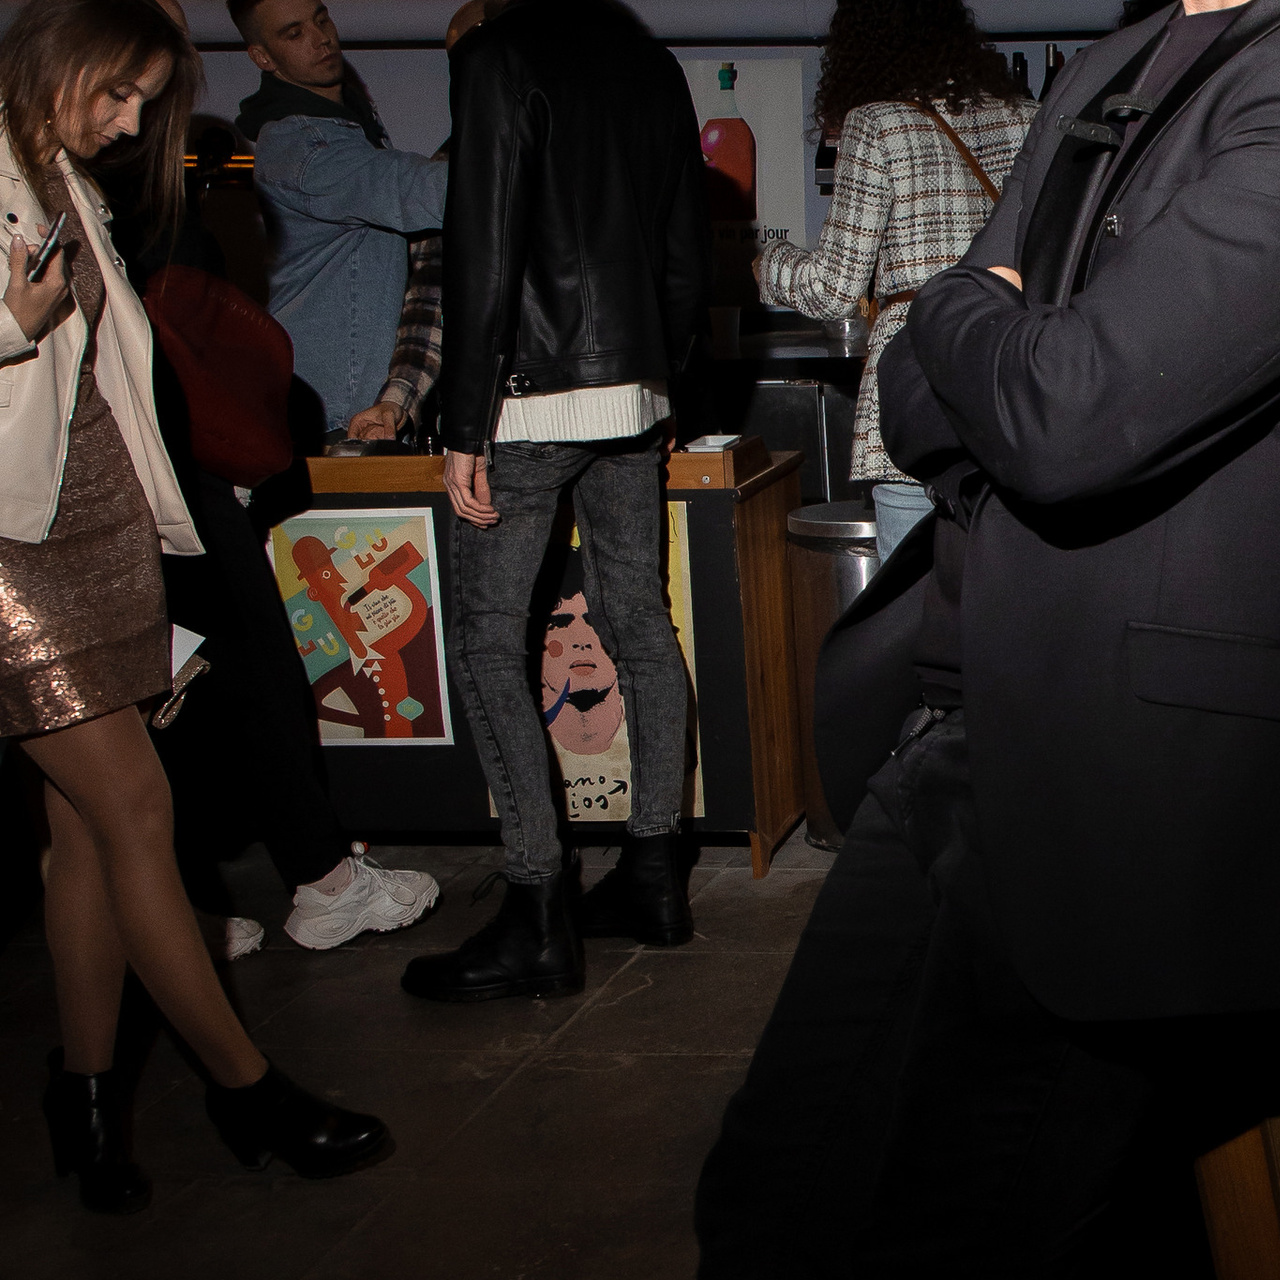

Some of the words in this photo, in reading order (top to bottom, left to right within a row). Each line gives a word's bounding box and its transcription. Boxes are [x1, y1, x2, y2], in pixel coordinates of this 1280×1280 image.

[719, 226, 736, 239] vin
[741, 227, 760, 244] par
[761, 225, 790, 244] jour
[564, 775, 606, 788] ano
